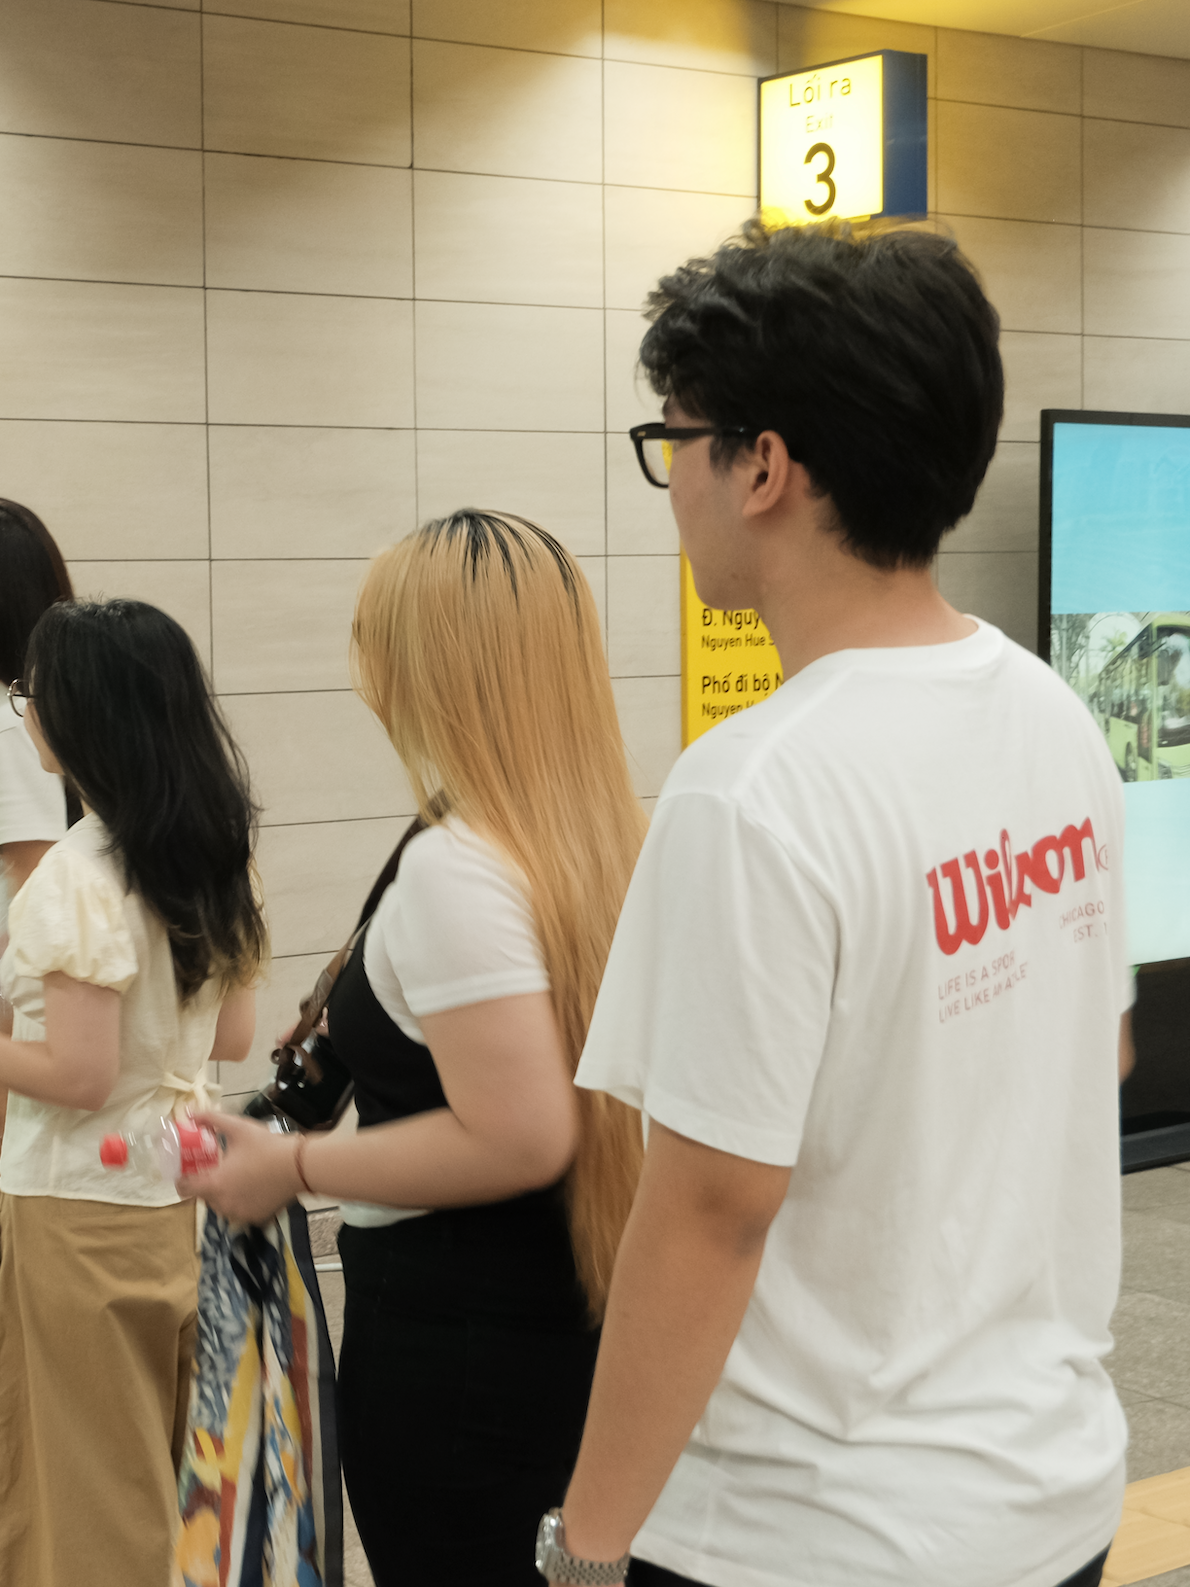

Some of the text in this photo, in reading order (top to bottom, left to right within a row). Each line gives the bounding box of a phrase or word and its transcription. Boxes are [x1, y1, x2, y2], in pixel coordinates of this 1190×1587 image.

[789, 74, 852, 108] Lối ra
[805, 113, 834, 134] Exit
[804, 142, 836, 216] 3
[722, 610, 760, 630] Nguy
[701, 635, 742, 652] Nguyen
[745, 633, 765, 647] Hue
[702, 672, 732, 694] Phố
[735, 674, 748, 693] đi
[753, 673, 770, 697] bộ
[702, 702, 743, 719] Nguyen
[938, 975, 961, 1000] LIFE
[965, 969, 977, 987] IS
[980, 965, 989, 981] A
[939, 1000, 960, 1024] LIVE
[964, 988, 990, 1011] LIKE
